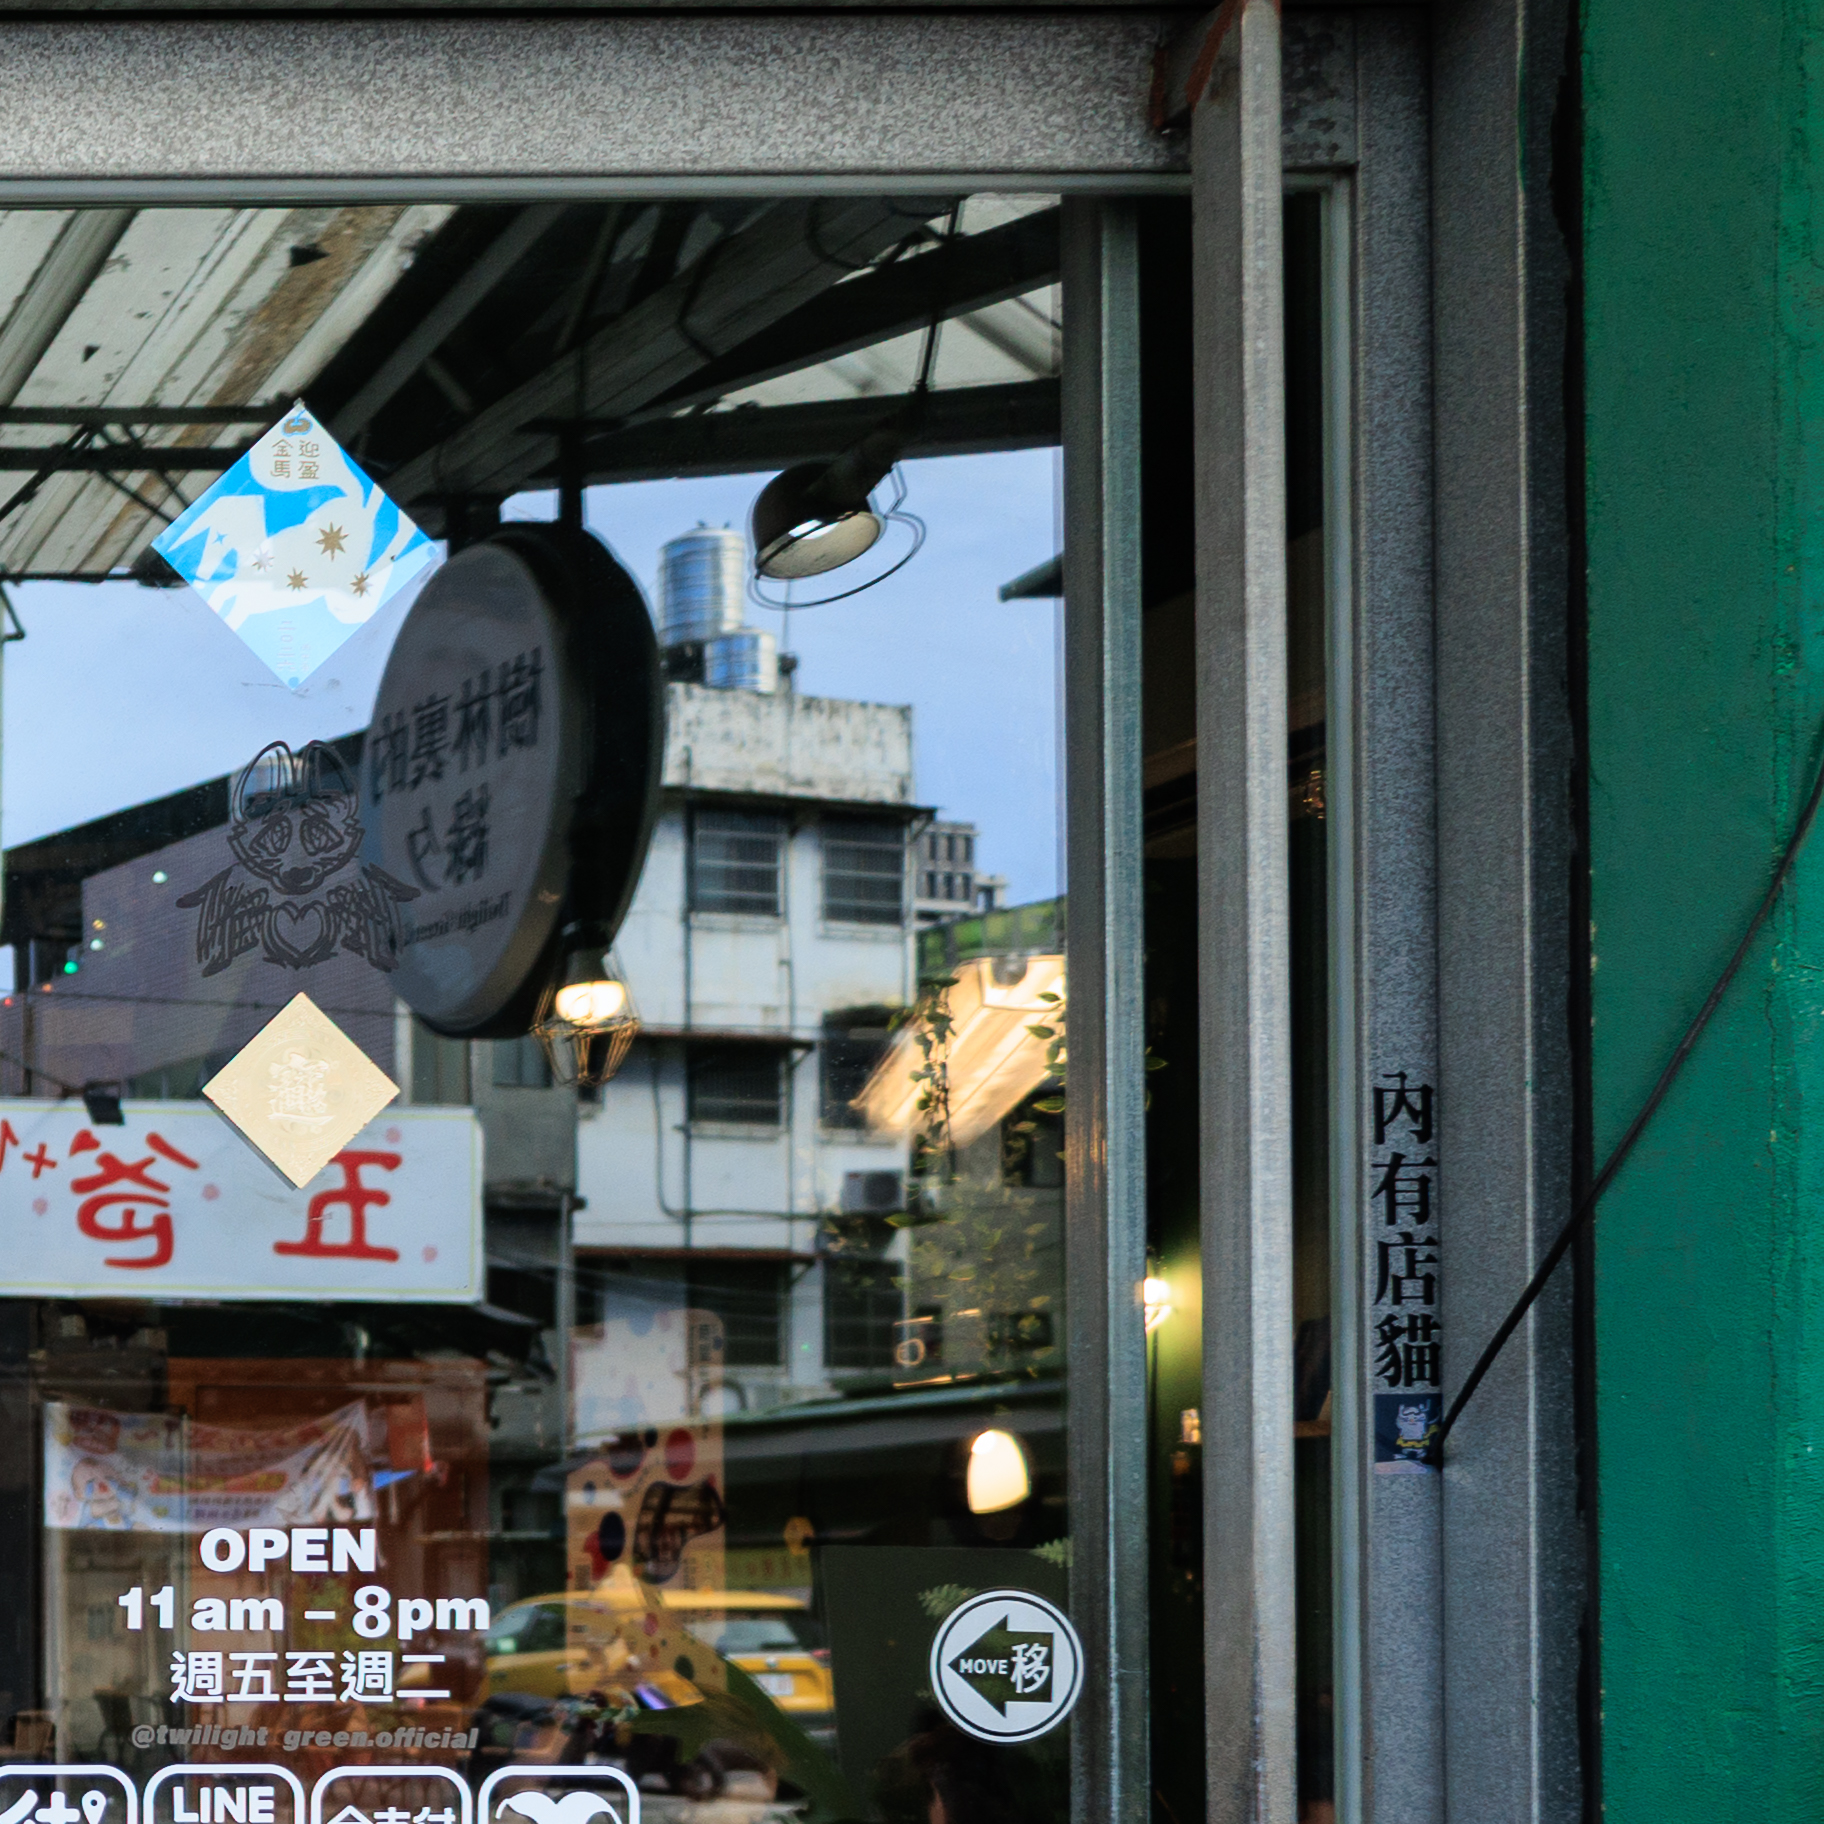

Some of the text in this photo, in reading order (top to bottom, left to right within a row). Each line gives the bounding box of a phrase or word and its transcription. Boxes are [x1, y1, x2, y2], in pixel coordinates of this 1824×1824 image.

[1371, 1070, 1442, 1388] 內有店貓
[199, 1528, 376, 1573] OPEN
[169, 1650, 451, 1703] 週五至週二
[959, 1658, 1008, 1675] MOVE
[1010, 1642, 1050, 1693] 移
[173, 1786, 276, 1824] LINE
